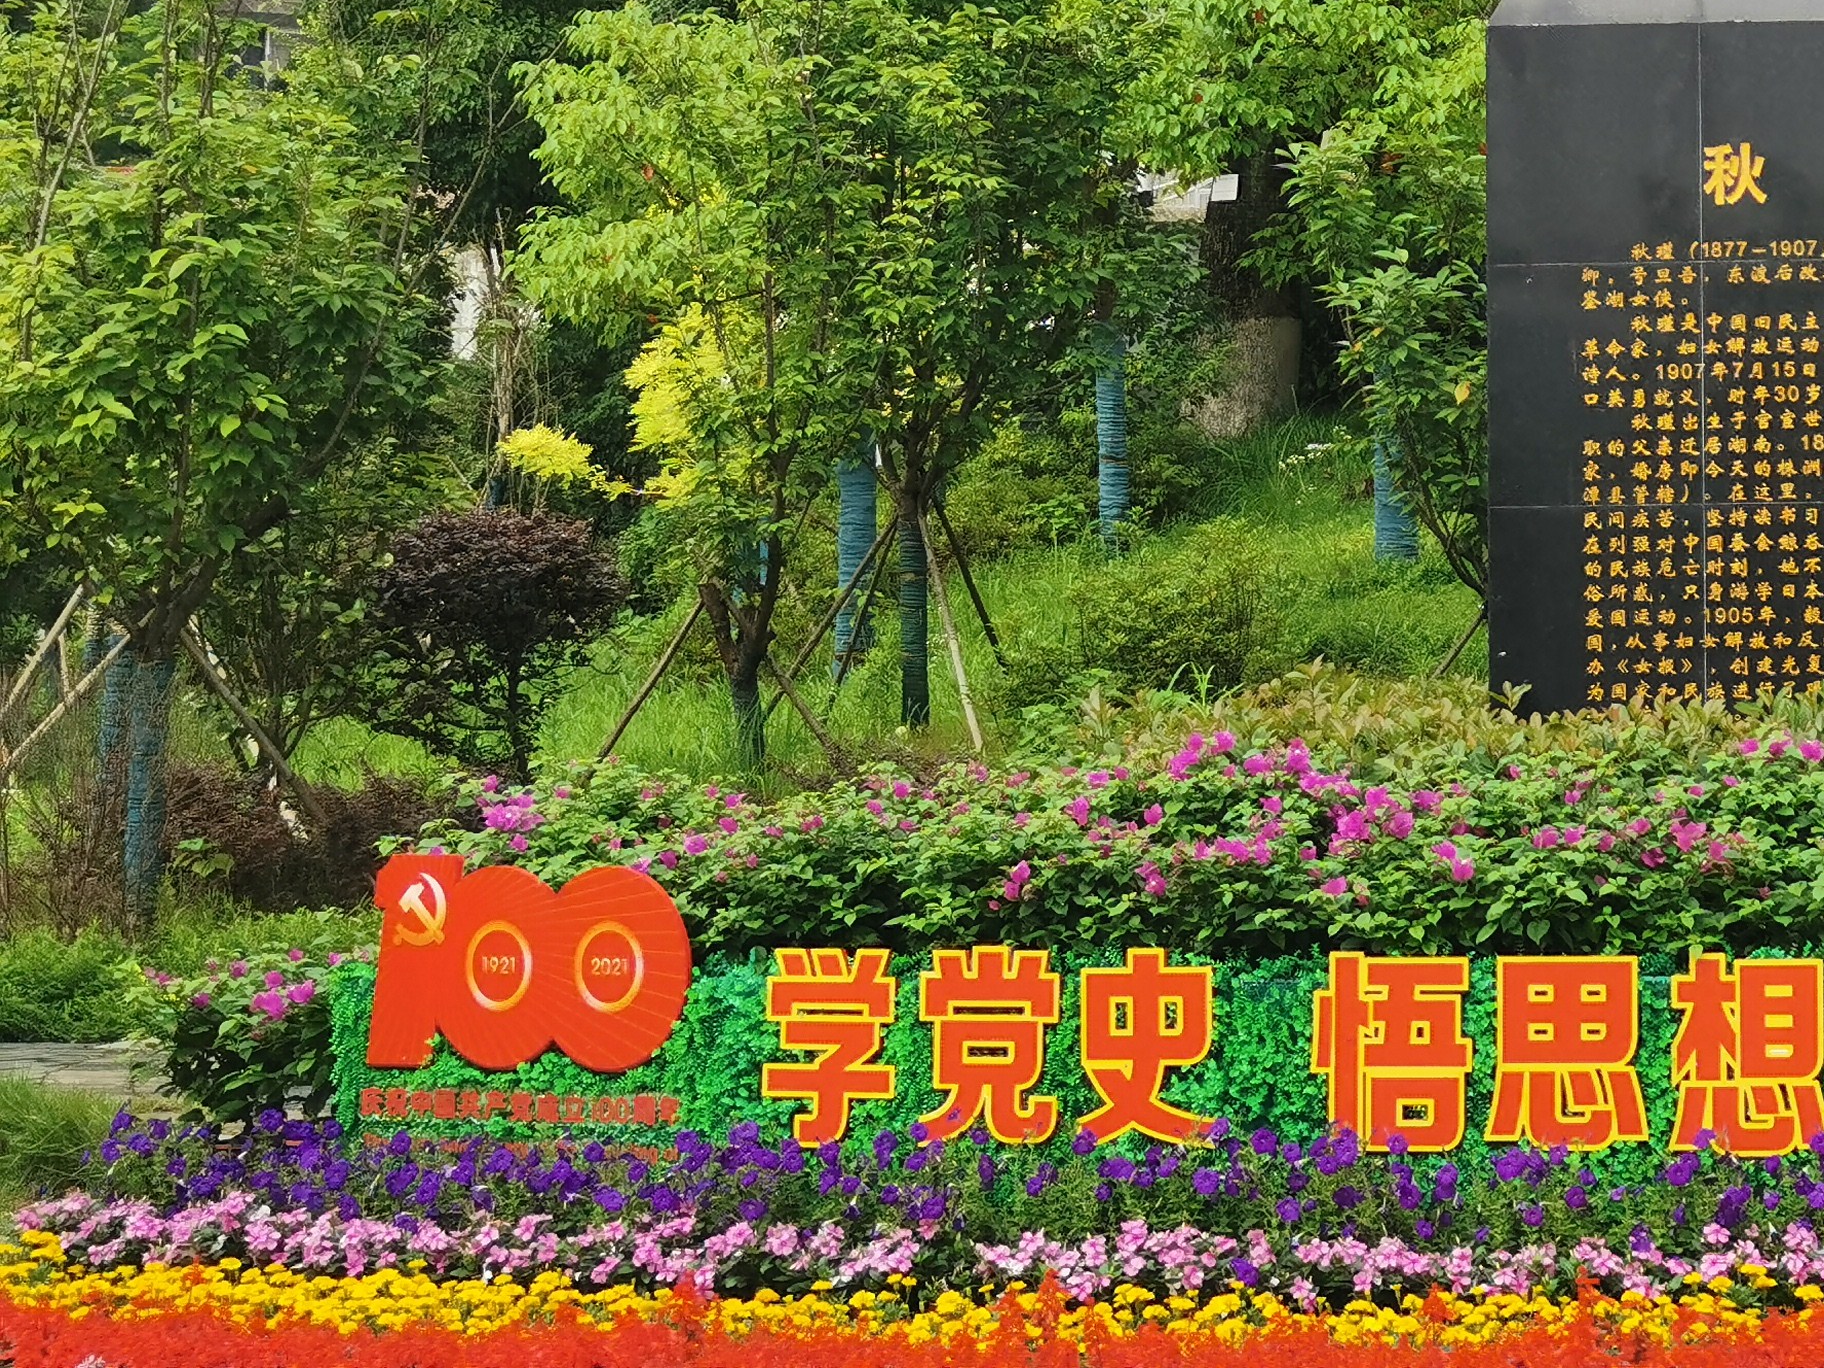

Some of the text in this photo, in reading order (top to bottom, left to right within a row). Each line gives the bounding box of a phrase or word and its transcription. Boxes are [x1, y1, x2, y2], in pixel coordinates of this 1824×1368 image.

[366, 854, 692, 1073] 100
[481, 955, 629, 976] 1921 2021
[762, 945, 1214, 1149] 学党史
